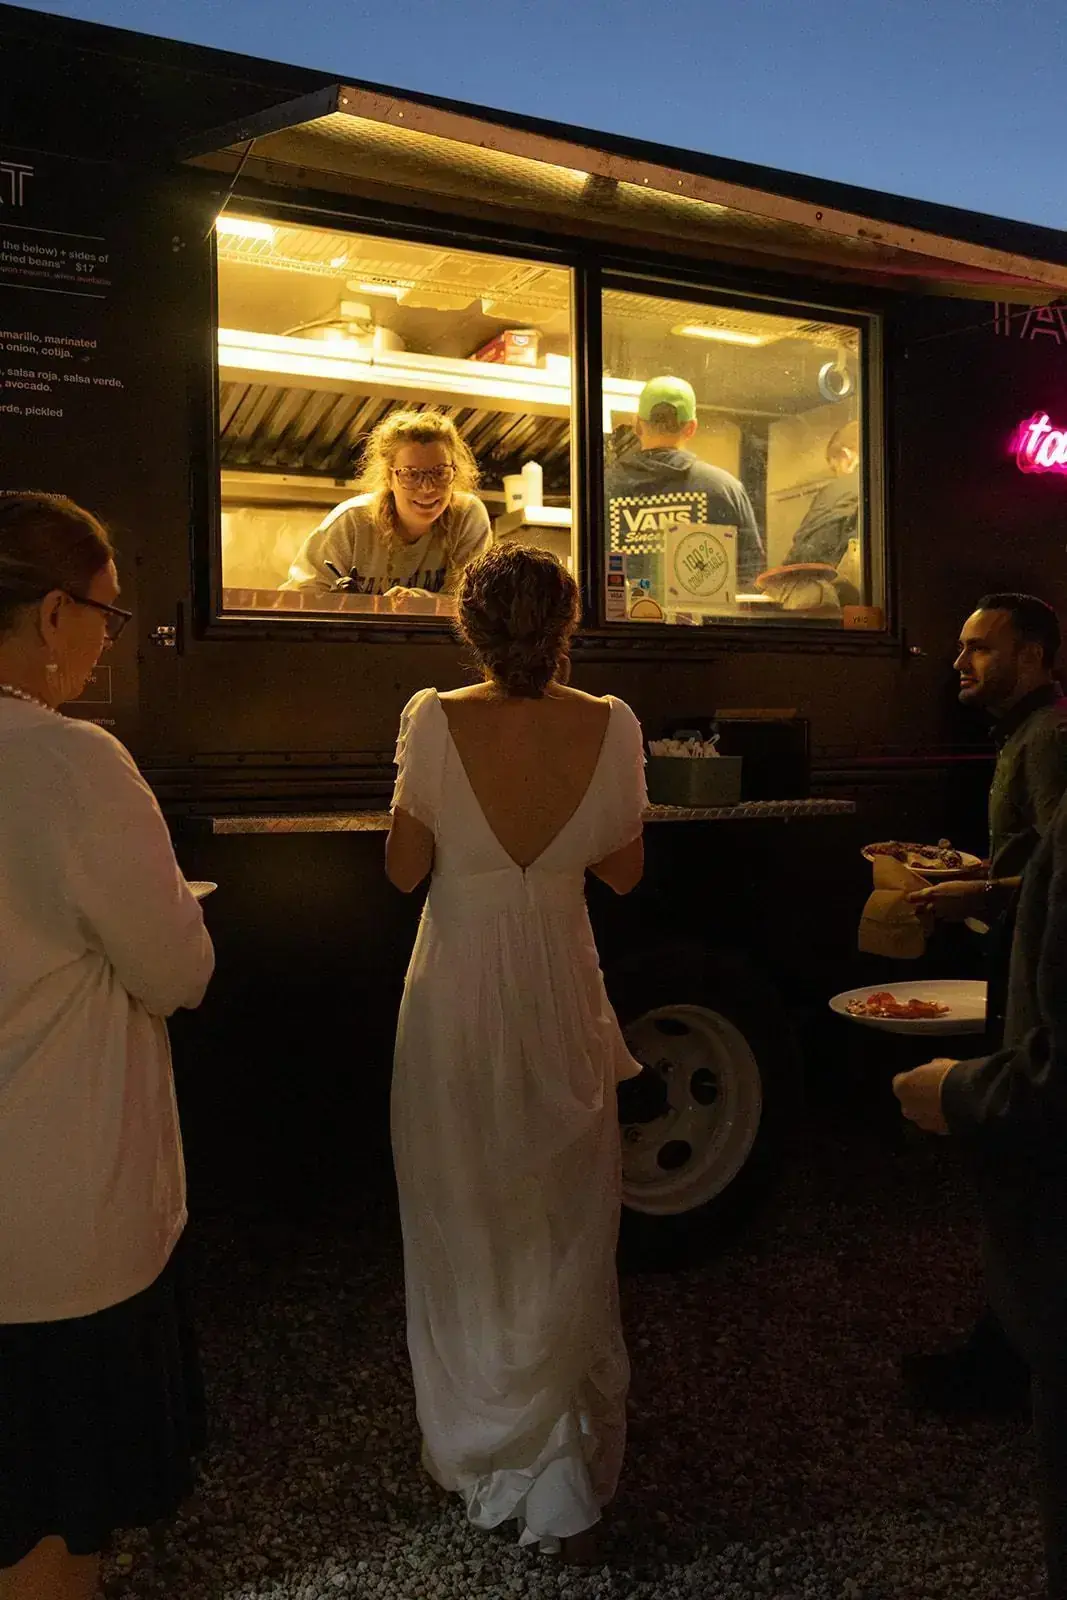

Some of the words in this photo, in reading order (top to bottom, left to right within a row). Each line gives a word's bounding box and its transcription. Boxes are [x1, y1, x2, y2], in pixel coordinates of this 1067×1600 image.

[0, 160, 35, 207] T
[0, 251, 26, 265] fried
[75, 262, 96, 273] $17
[2, 239, 20, 251] the
[22, 242, 58, 258] below)
[68, 250, 96, 262] sides
[98, 254, 110, 264] of
[6, 342, 39, 355] onion,
[44, 334, 98, 349] marinated
[7, 368, 36, 379] salsa
[37, 370, 61, 382] roja,
[63, 373, 91, 384] salsa
[92, 376, 125, 389] verde,
[25, 405, 63, 418] pickled
[621, 505, 692, 532] VANS
[682, 539, 714, 573] 100%
